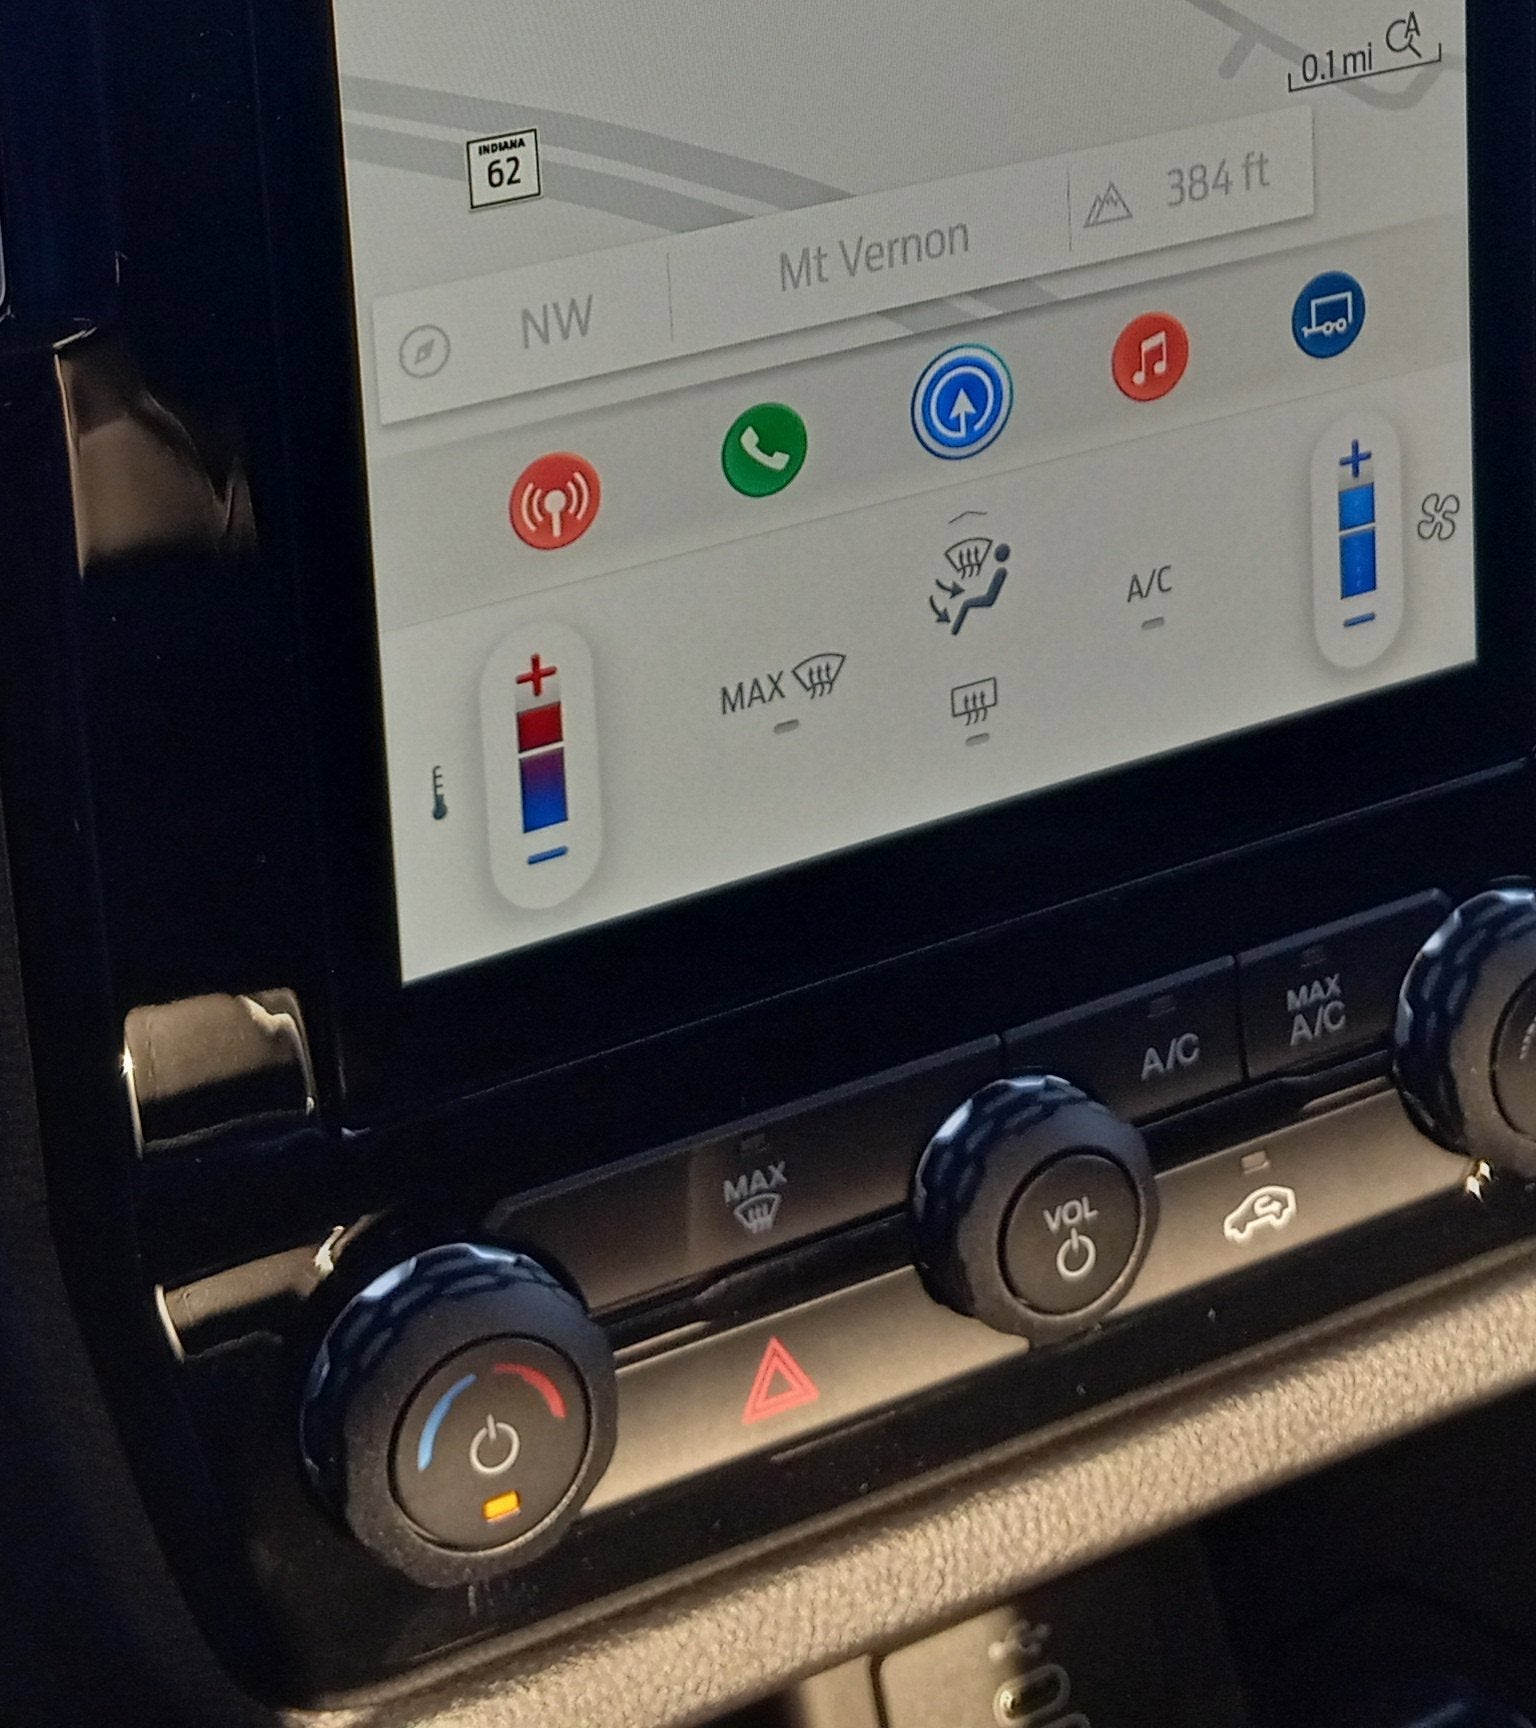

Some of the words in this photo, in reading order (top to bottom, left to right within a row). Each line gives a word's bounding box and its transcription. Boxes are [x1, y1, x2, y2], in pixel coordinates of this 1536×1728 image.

[1301, 49, 1335, 84] 0.1
[1341, 41, 1373, 73] mi
[478, 138, 526, 156] INDIANA
[487, 156, 522, 188] 62
[1166, 159, 1234, 208] 384
[1240, 152, 1270, 190] ft
[778, 245, 830, 292] Mt
[837, 220, 970, 279] Vernon
[521, 294, 595, 349] NW
[1126, 566, 1174, 603] A/C
[721, 670, 786, 715] MAX
[1285, 974, 1342, 1012] MAX
[1290, 1000, 1348, 1046] A/C
[1141, 1032, 1201, 1080] A/C
[722, 1160, 789, 1204] MAX
[1043, 1195, 1100, 1233] VOL
